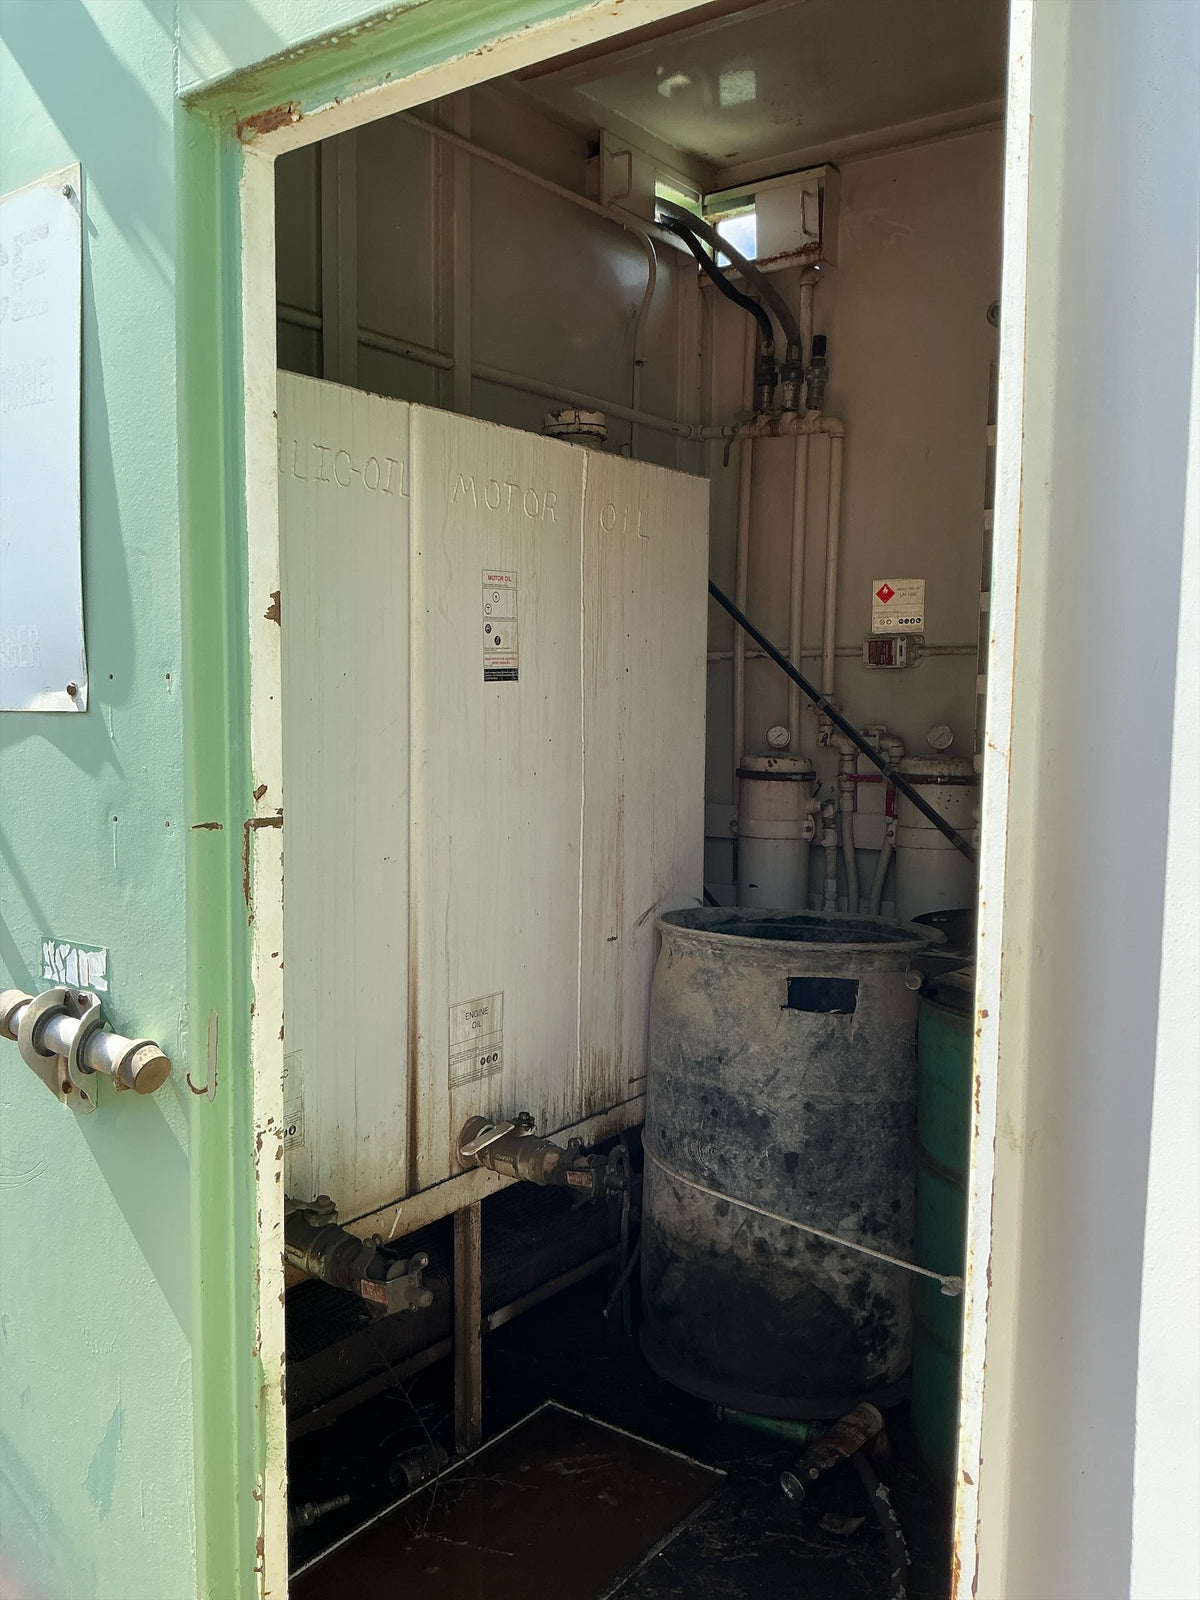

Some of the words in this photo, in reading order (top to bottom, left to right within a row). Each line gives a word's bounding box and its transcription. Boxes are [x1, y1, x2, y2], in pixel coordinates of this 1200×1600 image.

[450, 473, 557, 524] MOTOR
[600, 503, 649, 540] OIL
[487, 574, 504, 582] MOTOR
[465, 1006, 489, 1020] ENGINE
[471, 1021, 482, 1029] OIL
